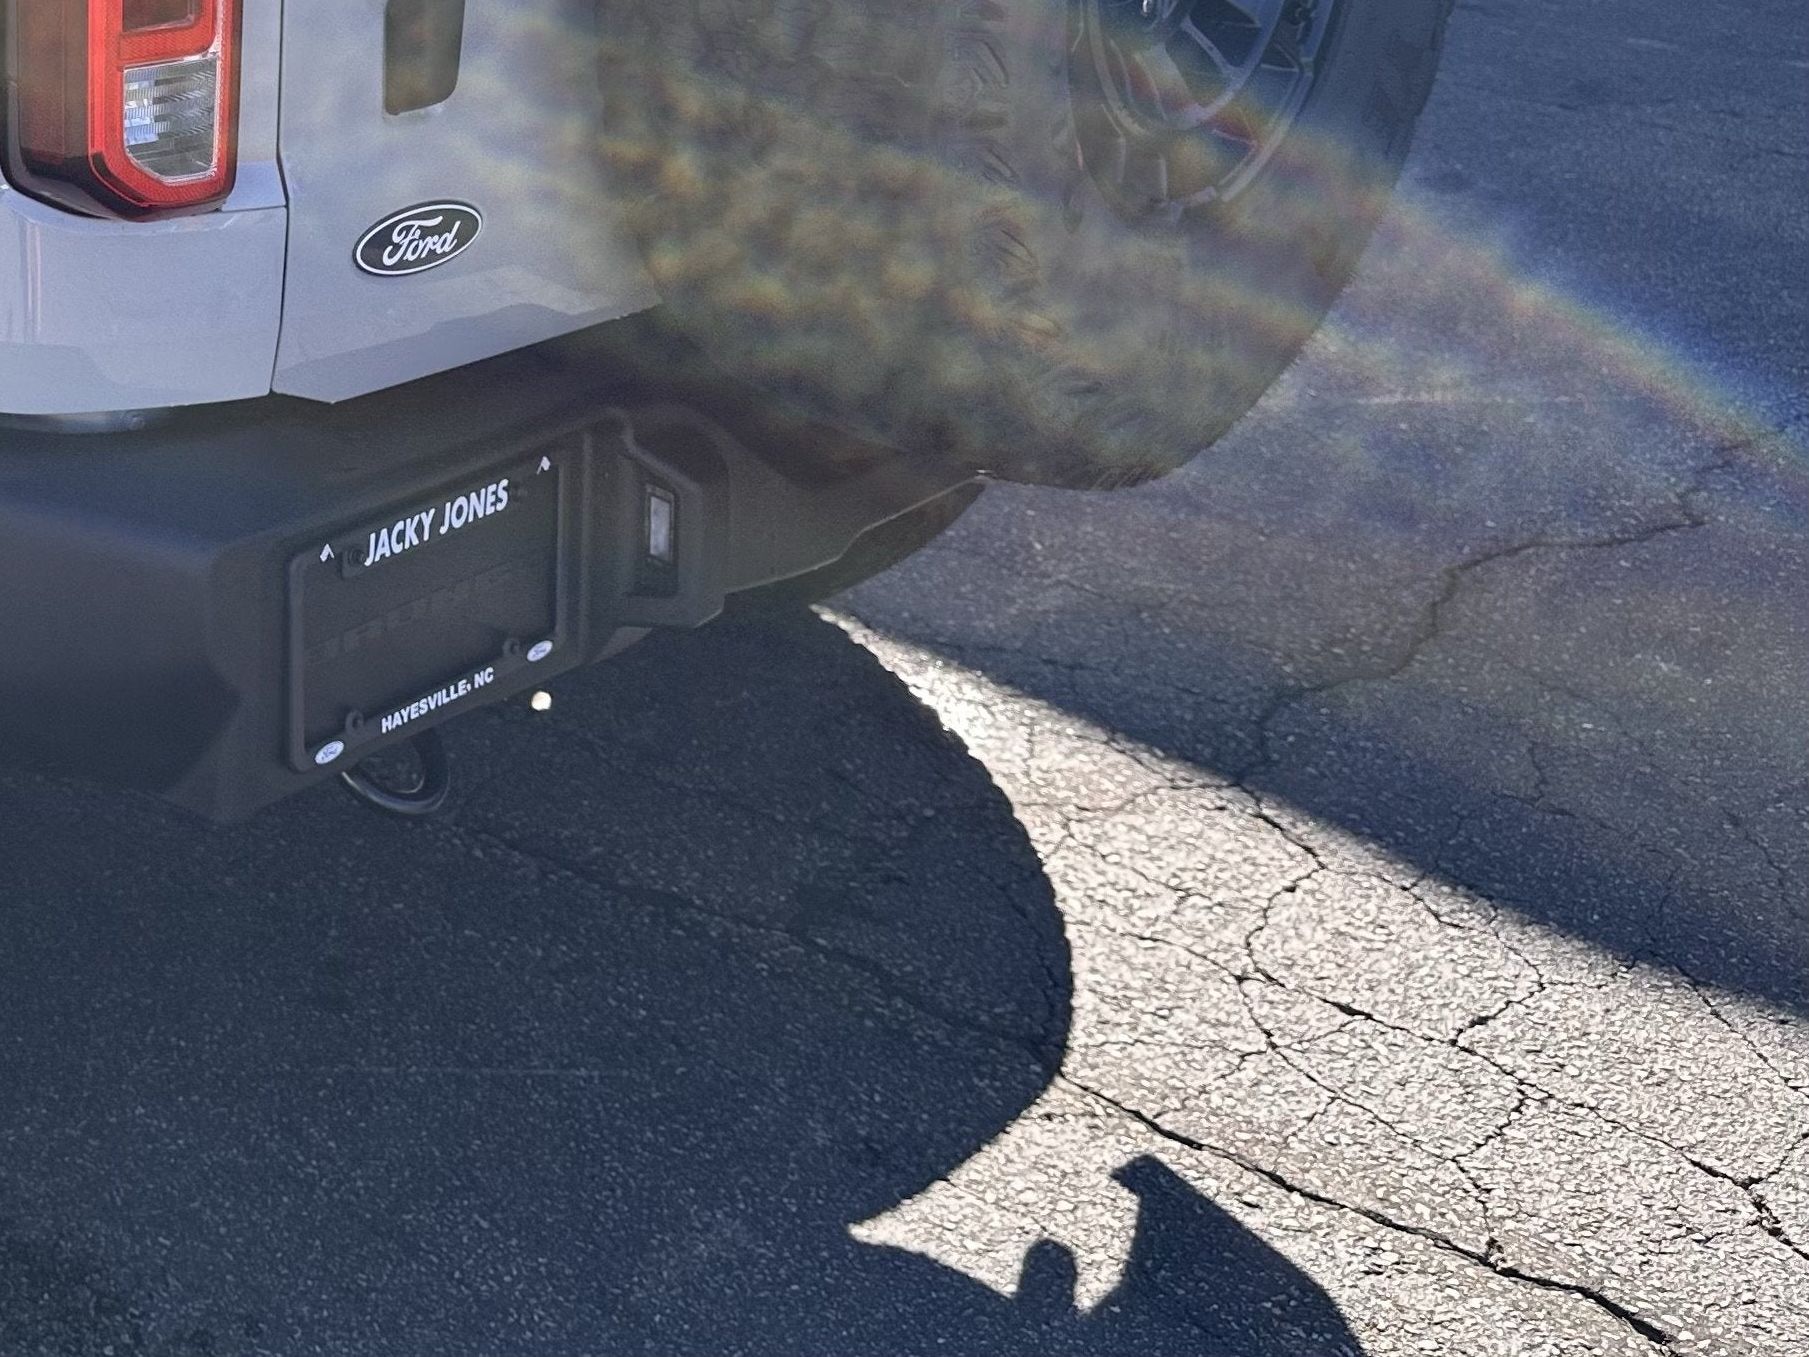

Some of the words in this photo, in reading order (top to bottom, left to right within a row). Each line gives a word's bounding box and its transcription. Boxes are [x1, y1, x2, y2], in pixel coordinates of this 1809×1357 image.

[382, 216, 461, 266] Ford
[364, 508, 435, 567] JACKY
[439, 479, 510, 535] JONES
[474, 666, 495, 690] NC
